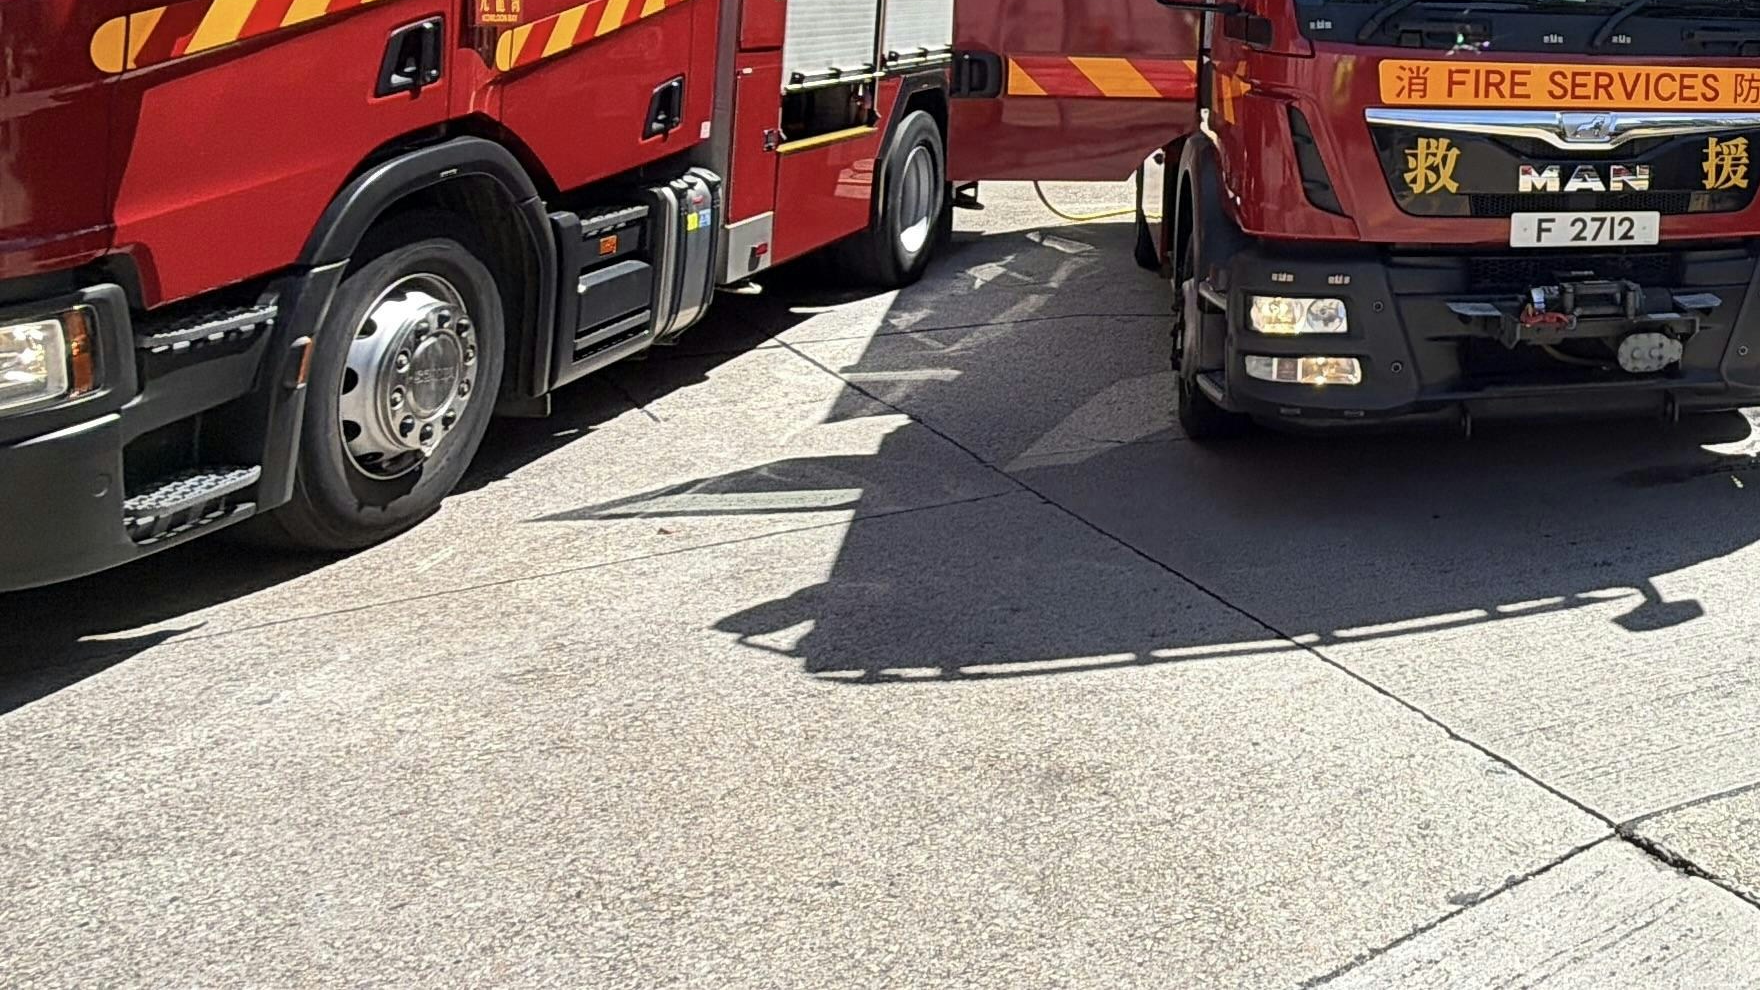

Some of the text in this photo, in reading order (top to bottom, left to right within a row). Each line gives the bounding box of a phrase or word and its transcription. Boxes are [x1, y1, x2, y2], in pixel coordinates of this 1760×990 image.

[1395, 65, 1430, 99] 消
[1446, 68, 1531, 99] FIRE
[1547, 70, 1720, 102] SERVICES
[1403, 136, 1750, 194] 救 MAN 援
[1536, 216, 1635, 243] F 2712
